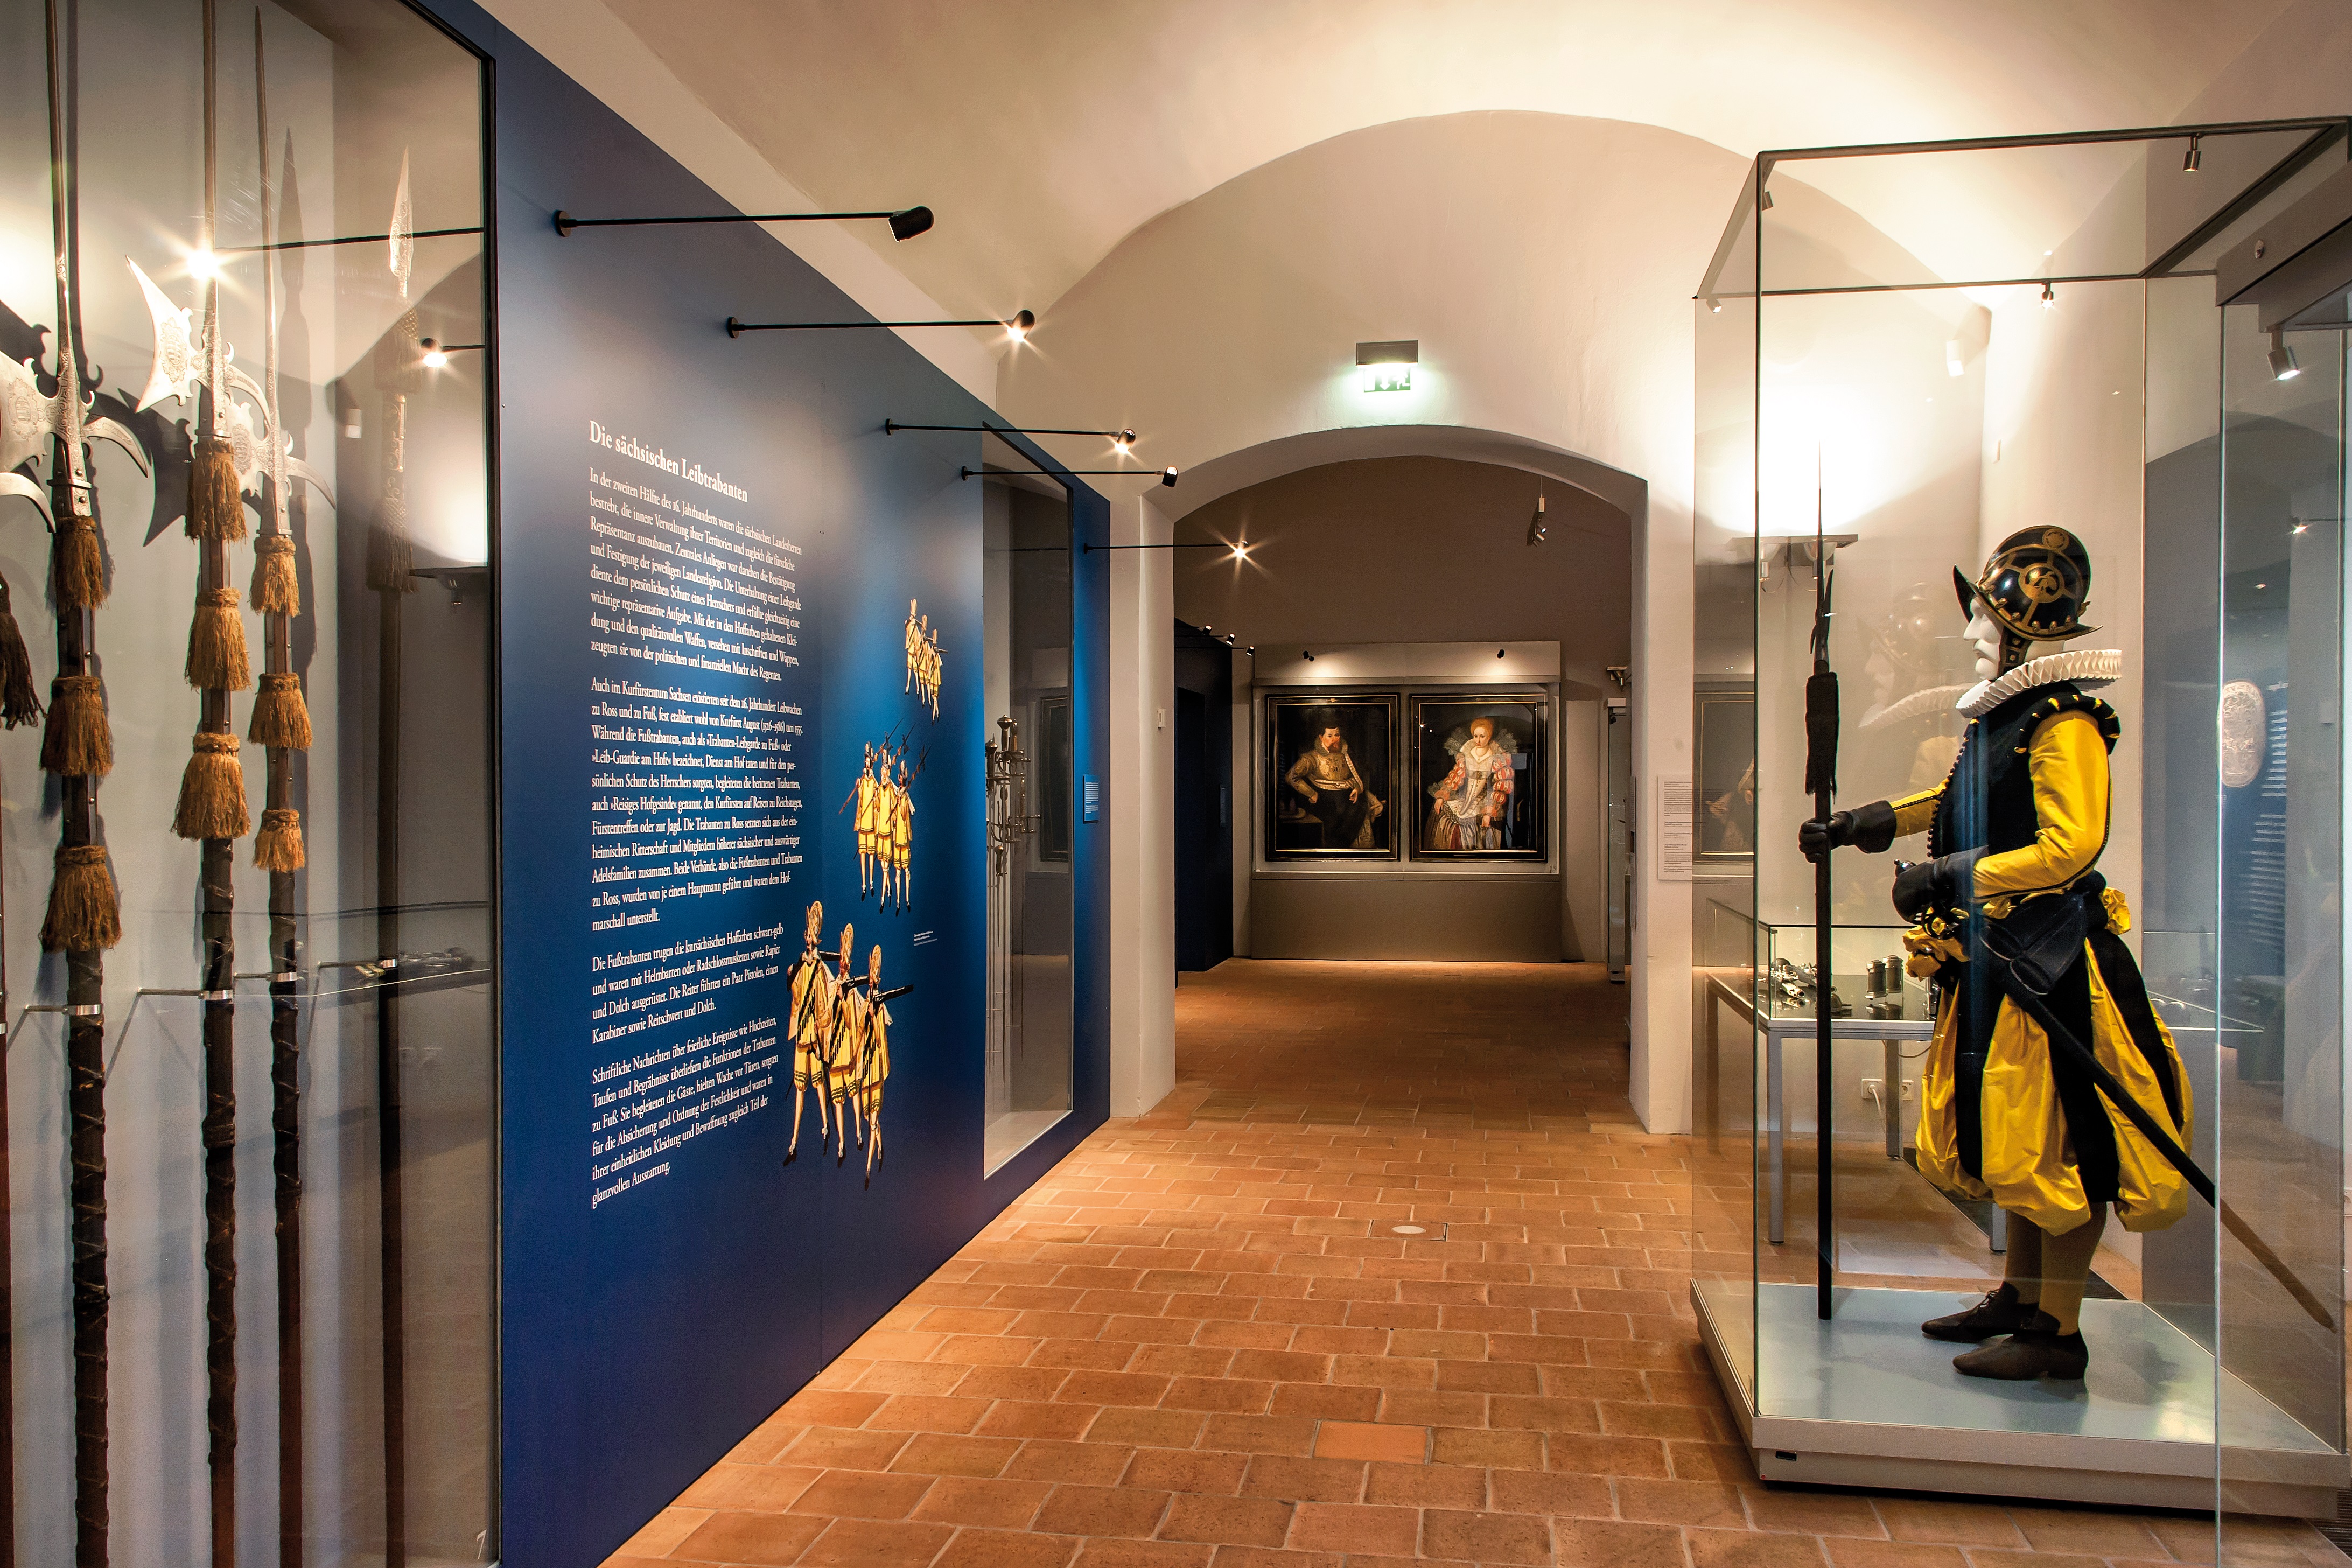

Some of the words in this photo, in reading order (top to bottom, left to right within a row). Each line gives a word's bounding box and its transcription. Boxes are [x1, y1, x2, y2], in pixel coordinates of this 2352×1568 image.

[590, 420, 612, 449] Die
[615, 435, 680, 476] sächsischen
[681, 458, 748, 503] Leibtrabanten
[590, 467, 599, 484] In
[599, 471, 612, 488] der
[613, 480, 638, 498] zweiten
[639, 485, 660, 506] Hälfte
[661, 493, 671, 509] des
[681, 501, 718, 526] Jahrhunderts
[590, 491, 619, 516] bestrebt,
[621, 502, 632, 519] die
[633, 507, 653, 526] innere
[654, 513, 689, 541] Verwaltung
[689, 526, 704, 542] ihrer
[590, 515, 636, 542] Repräsentanz
[636, 535, 674, 554] auszubauen.
[675, 542, 702, 562] Zentrales
[591, 542, 605, 557] und
[606, 544, 639, 571] Festigung
[639, 554, 650, 569] der
[652, 558, 681, 580] jeweiligen
[590, 564, 612, 583] diente
[613, 570, 629, 587] dem
[630, 578, 669, 597] persönlichen
[670, 584, 691, 602] Schutz
[691, 591, 705, 606] eines
[590, 590, 620, 612] wichtige
[621, 599, 665, 618] repräsentative
[666, 606, 693, 626] Aufgabe.
[694, 611, 705, 627] Mit
[705, 614, 716, 628] der
[591, 612, 610, 634] dung
[611, 618, 625, 632] und
[626, 619, 639, 635] den
[640, 624, 684, 643] qualitätsvollen
[591, 641, 618, 657] zeugten
[619, 642, 628, 656] sie
[629, 647, 642, 658] von
[642, 645, 654, 660] der
[655, 648, 688, 666] politischen
[688, 654, 701, 668] und
[591, 677, 610, 692] Auch
[611, 680, 621, 694] im
[622, 680, 668, 699] Kurfürstentum
[669, 687, 692, 702] Sachsen
[692, 691, 719, 705] existierten
[591, 705, 600, 715] zu
[601, 702, 618, 717] Ross
[619, 704, 633, 718] und
[633, 710, 642, 719] zu
[642, 705, 657, 723] Fuß,
[659, 706, 670, 722] fest
[670, 709, 694, 724] etabliert
[694, 711, 709, 725] wohl
[709, 717, 719, 726] von
[591, 724, 625, 741] Während
[625, 726, 636, 741] die
[638, 728, 681, 746] Fußtrabanten,
[681, 731, 697, 745] auch
[697, 732, 705, 746] als
[641, 755, 652, 765] am
[591, 772, 624, 787] sönlichen
[626, 773, 648, 788] Schutz
[648, 773, 659, 788] des
[660, 774, 692, 788] Herrschers
[592, 796, 609, 811] auch
[703, 796, 715, 809] den
[592, 818, 639, 835] Fürstentreffen
[640, 818, 655, 833] oder
[655, 823, 667, 832] zur
[666, 817, 682, 836] Jagd.
[683, 817, 695, 831] Die
[695, 816, 724, 830] Trabanten
[592, 843, 631, 859] heimischen
[631, 839, 668, 856] Ritterschaft
[669, 839, 682, 853] und
[682, 838, 716, 856] Mitgliedern
[591, 865, 637, 883] Adelsfamilien
[638, 867, 673, 879] zusammen.
[673, 860, 690, 875] Beide
[592, 897, 601, 907] zu
[603, 891, 621, 906] Ross,
[621, 887, 647, 903] wurden
[648, 890, 661, 900] von
[661, 886, 668, 903] je
[668, 885, 687, 898] einem
[687, 881, 722, 898] Hauptmann
[592, 912, 626, 931] marschall
[626, 908, 660, 926] unterstellt.
[592, 957, 606, 971] Die
[607, 950, 652, 969] Fußtrabanten
[653, 947, 674, 962] trugen
[674, 941, 684, 955] die
[685, 934, 726, 953] kursächsischen
[592, 978, 607, 996] und
[608, 979, 629, 992] waren
[631, 972, 643, 987] mit
[643, 966, 681, 984] Helmbarten
[682, 961, 696, 975] oder
[592, 1002, 607, 1020] und
[608, 997, 630, 1016] Dolch
[631, 992, 668, 1012] ausgerüstet.
[669, 986, 681, 1000] Die
[682, 983, 699, 997] Reiter
[700, 978, 721, 992] führten
[592, 1024, 627, 1044] Karabiner
[627, 1017, 647, 1034] sowie
[647, 1009, 683, 1028] Reitschwert
[684, 1002, 696, 1018] und
[592, 1060, 632, 1084] Schriftliche
[633, 1049, 671, 1071] Nachrichten
[672, 1043, 686, 1058] über
[687, 1034, 711, 1053] feierliche
[592, 1088, 617, 1108] Taufen
[618, 1081, 632, 1099] und
[633, 1072, 670, 1095] Begräbnisse
[671, 1060, 701, 1080] überliefern
[702, 1055, 711, 1069] die
[592, 1121, 601, 1132] zu
[603, 1109, 619, 1129] Fuß:
[620, 1107, 631, 1122] Sie
[632, 1097, 665, 1119] begleiteten
[666, 1089, 676, 1104] die
[696, 1076, 715, 1093] hielten
[592, 1140, 604, 1157] für
[605, 1135, 616, 1151] die
[617, 1122, 657, 1146] Absicherung
[659, 1111, 671, 1129] und
[672, 1105, 699, 1123] Ordnung
[700, 1098, 710, 1112] der
[592, 1164, 610, 1181] ihrer
[611, 1145, 652, 1172] einheitlichen
[653, 1134, 682, 1154] Kleidung
[681, 1124, 694, 1141] und
[695, 1115, 728, 1136] Bewaffnung
[592, 1177, 631, 1210] glanzvollen
[631, 1161, 670, 1187] Ausstattung.
